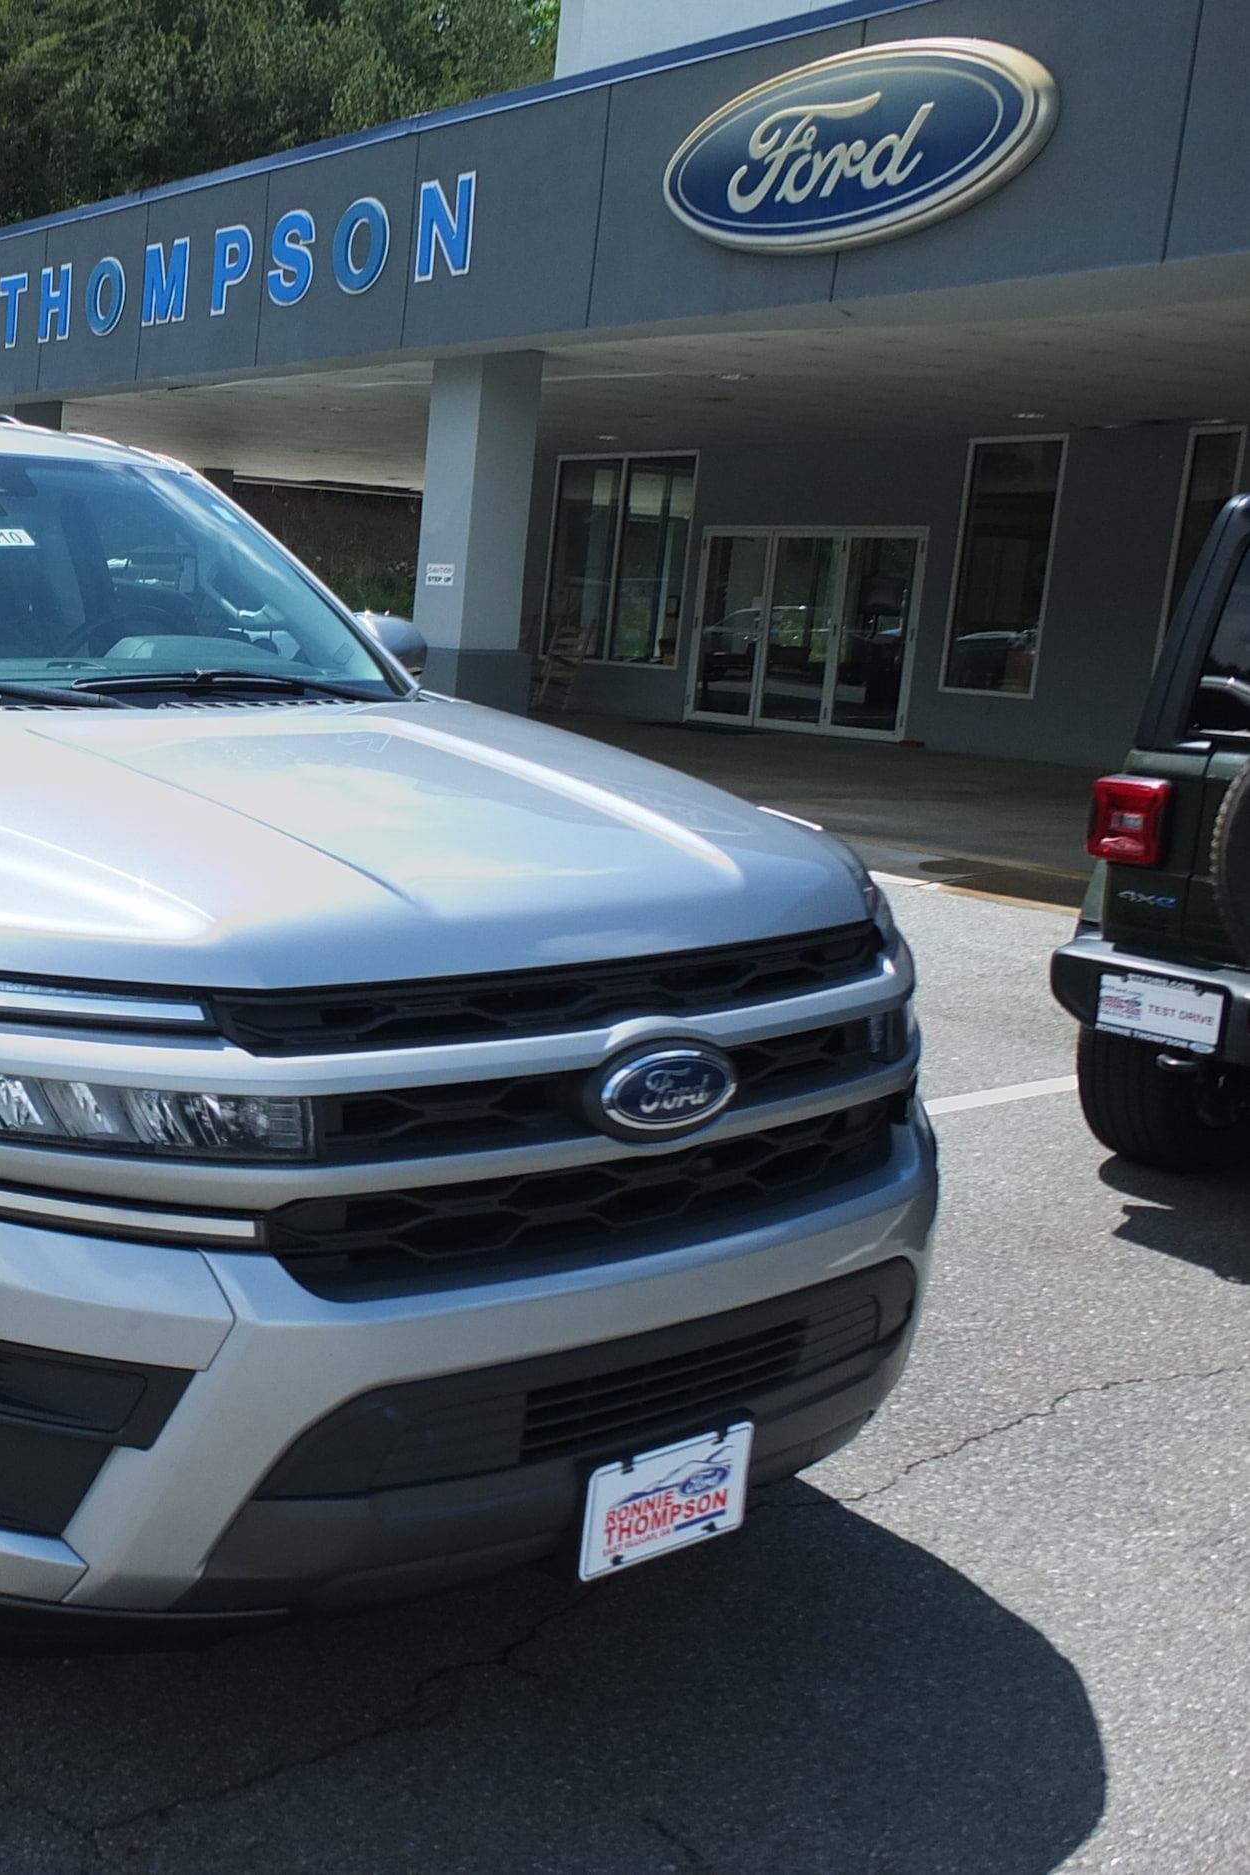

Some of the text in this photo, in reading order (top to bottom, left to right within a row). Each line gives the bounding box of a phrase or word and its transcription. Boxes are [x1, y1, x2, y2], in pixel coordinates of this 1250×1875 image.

[727, 91, 935, 213] Ford
[0, 170, 478, 349] THOMPSON
[1148, 1004, 1176, 1018] TEST
[1179, 1010, 1215, 1026] DRIVE
[639, 1067, 710, 1114] Ford
[684, 1470, 721, 1492] Ford
[604, 1488, 729, 1546] THOMPSON
[606, 1490, 675, 1528] RONNIE
